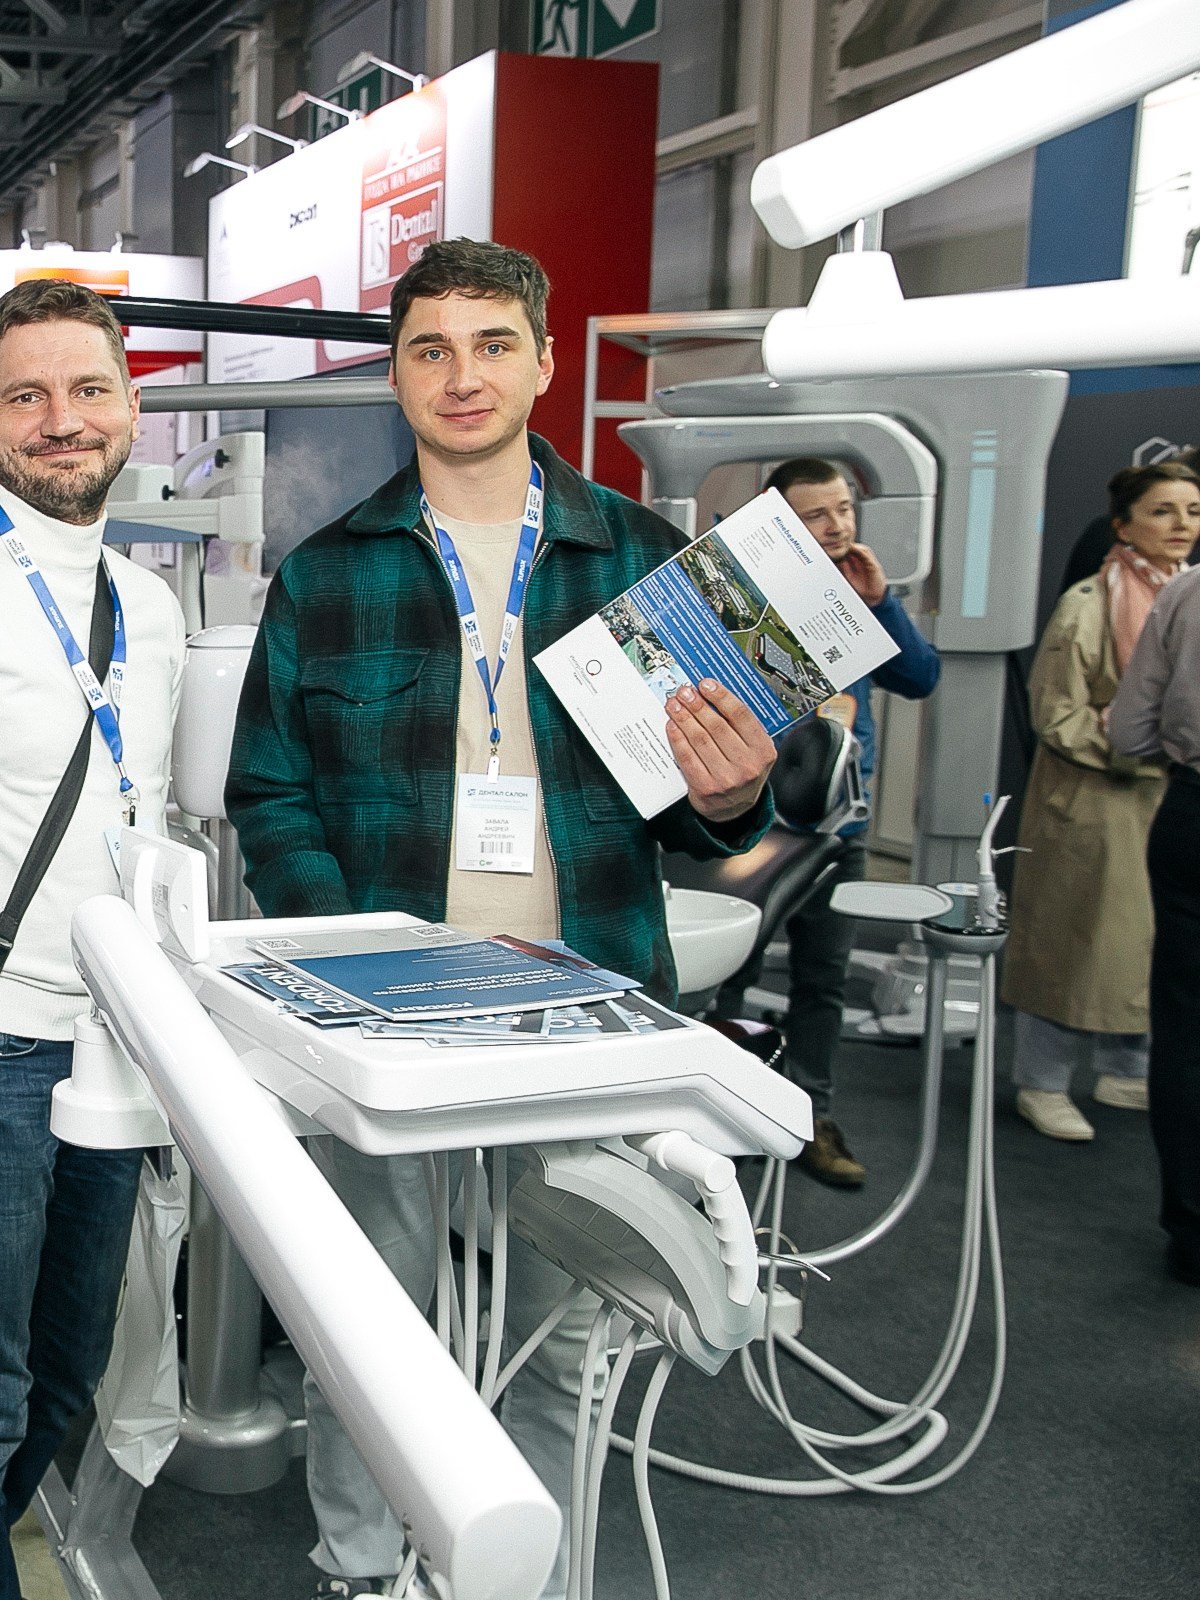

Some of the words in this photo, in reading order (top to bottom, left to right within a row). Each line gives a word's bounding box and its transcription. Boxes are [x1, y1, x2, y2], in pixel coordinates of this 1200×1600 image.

[773, 516, 813, 565] MinebeaMitsumi
[833, 599, 864, 637] myonic
[250, 967, 360, 1013] FORDENT
